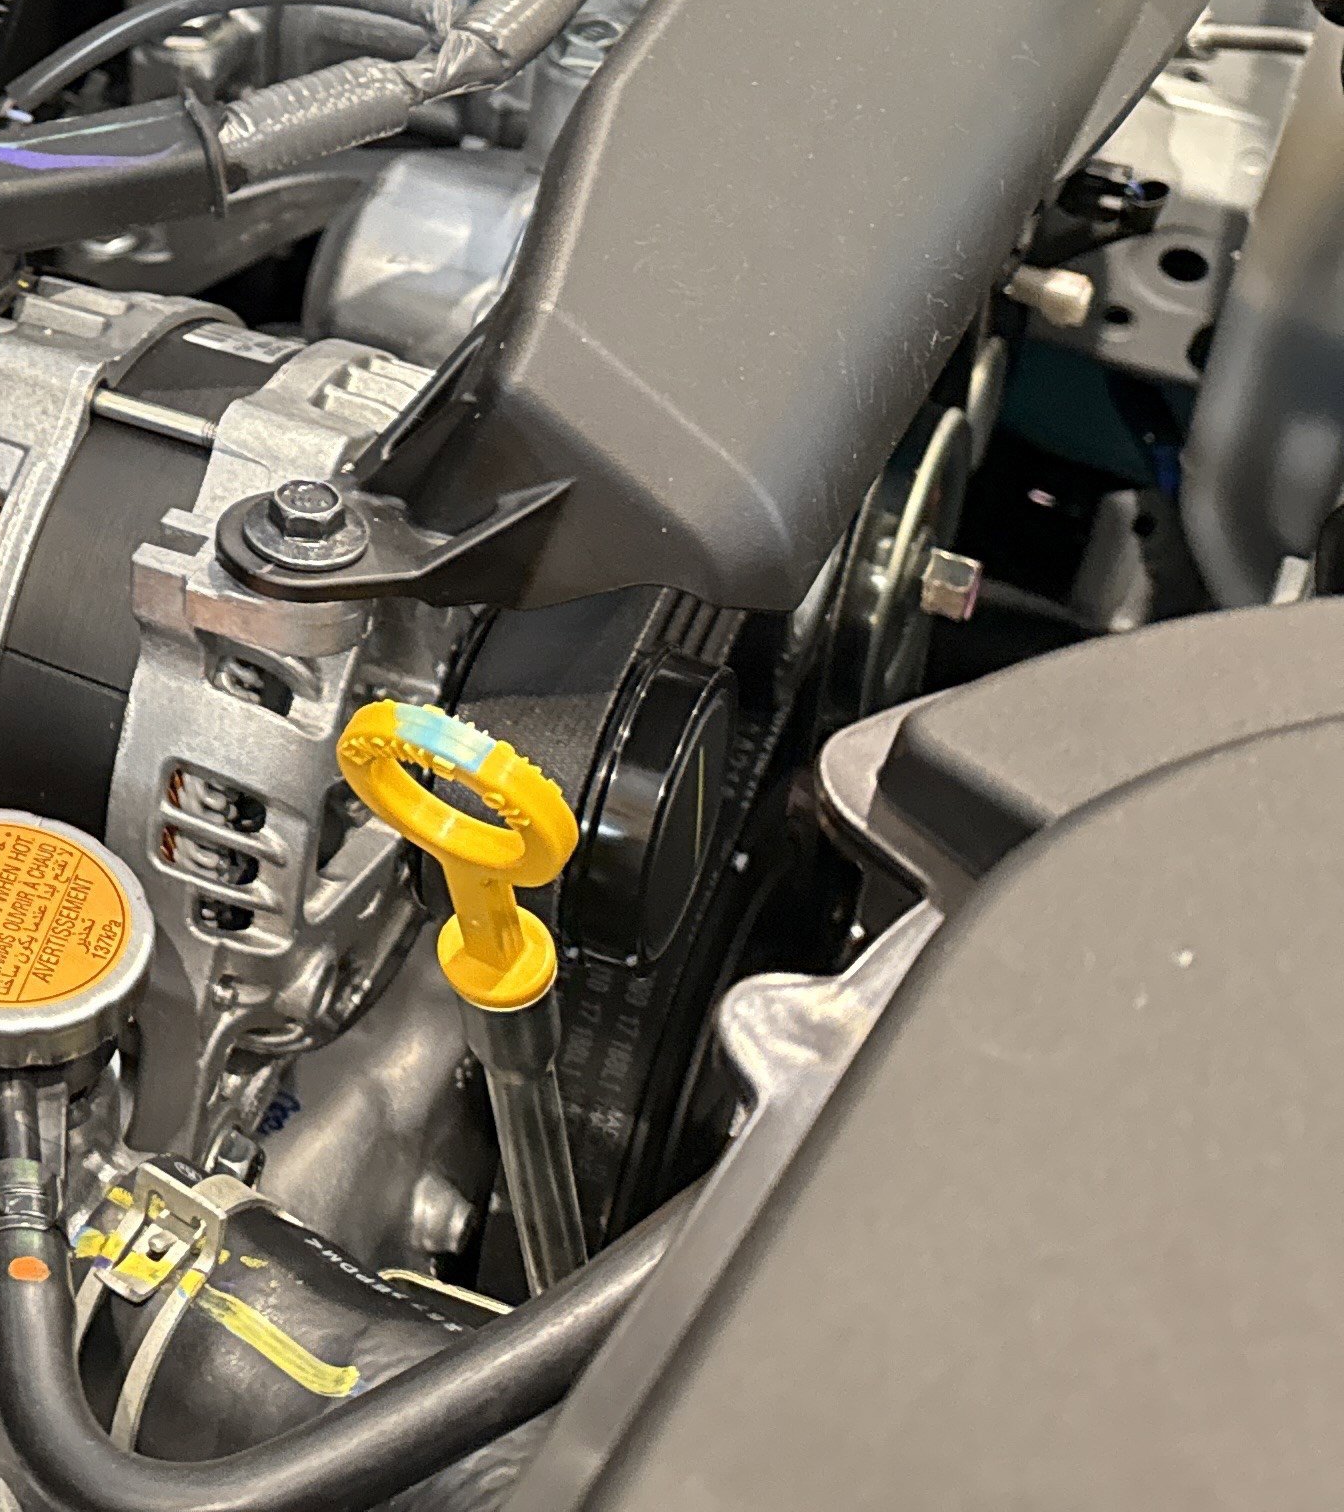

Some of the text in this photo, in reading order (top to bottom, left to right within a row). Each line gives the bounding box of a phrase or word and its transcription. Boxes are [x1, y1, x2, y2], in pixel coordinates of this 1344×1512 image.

[3, 891, 36, 932] OUVRIR
[26, 843, 57, 879] CHAUD
[32, 874, 94, 984] AVERTISSEMENT
[91, 920, 122, 960] 137kPa
